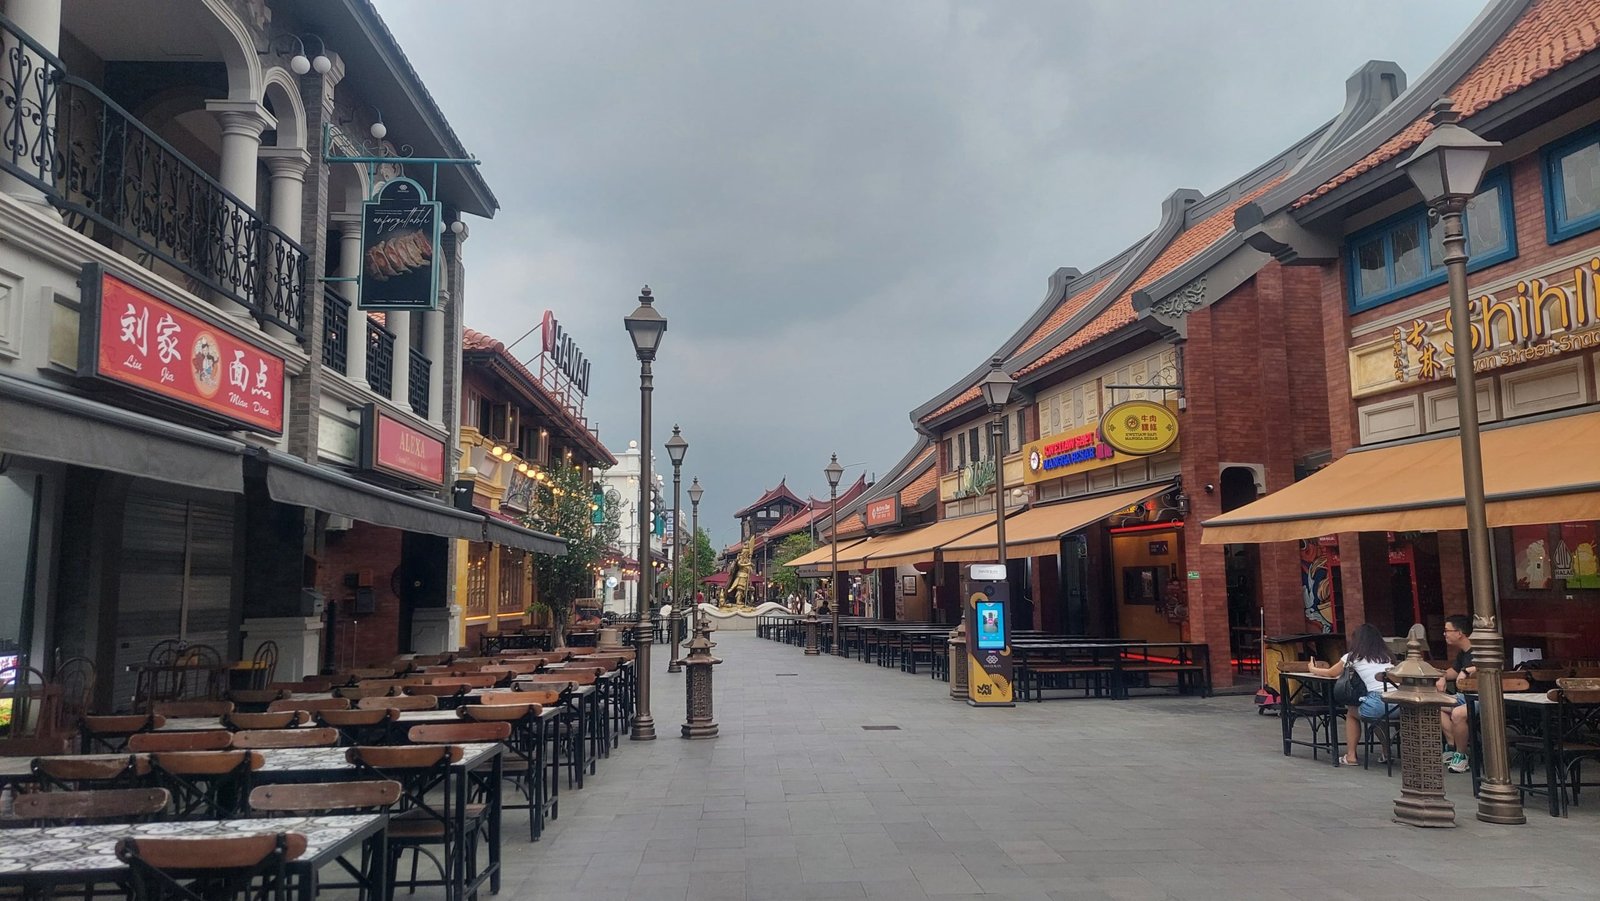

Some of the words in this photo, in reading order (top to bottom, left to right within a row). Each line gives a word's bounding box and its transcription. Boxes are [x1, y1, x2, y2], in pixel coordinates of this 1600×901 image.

[120, 303, 182, 364] 刘家
[229, 350, 272, 399] 面点
[1500, 340, 1552, 364] Street
[123, 354, 144, 371] Liu
[160, 367, 175, 383] Jia
[228, 392, 249, 408] Mian
[253, 401, 270, 416] Dian
[399, 431, 425, 459] ALEXA
